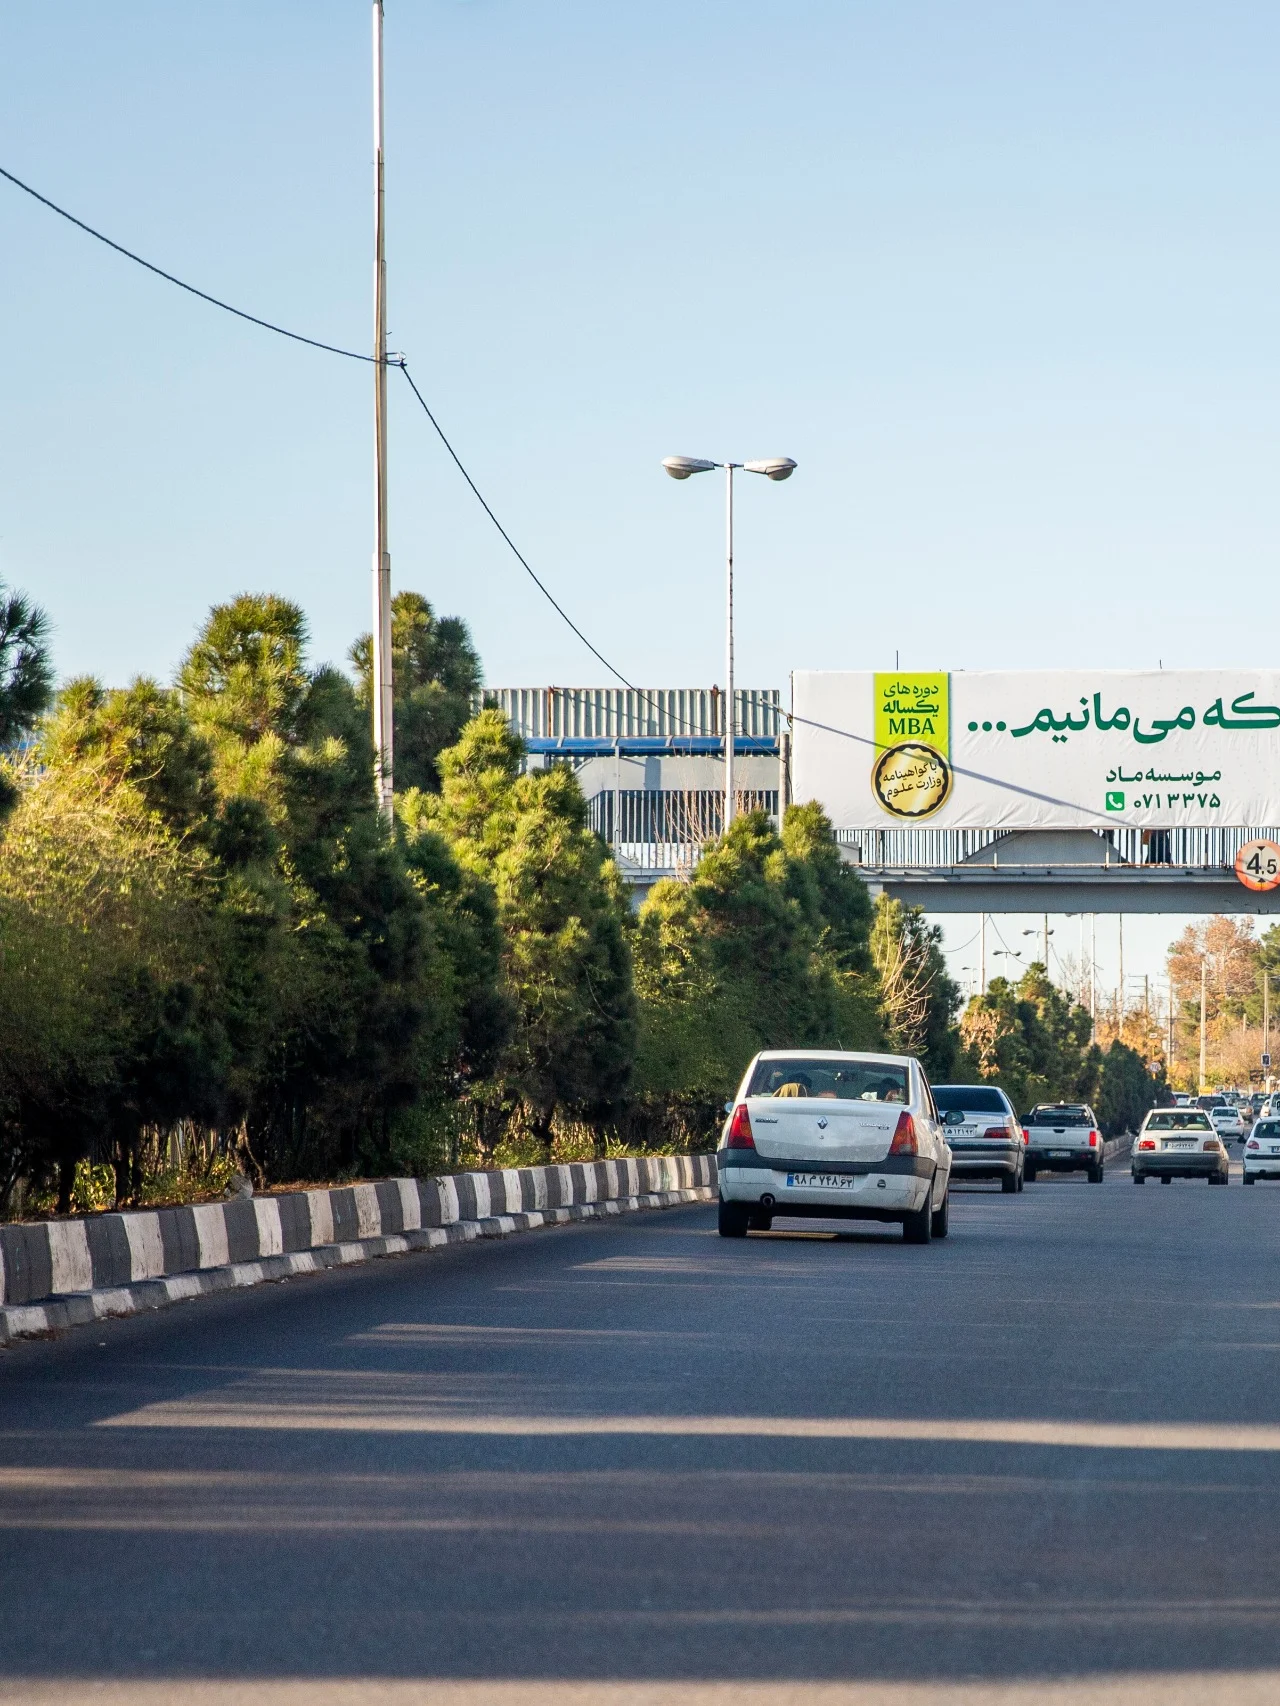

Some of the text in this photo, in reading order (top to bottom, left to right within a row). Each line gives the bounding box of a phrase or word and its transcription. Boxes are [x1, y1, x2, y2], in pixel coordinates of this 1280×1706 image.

[883, 682, 939, 698] دوره های
[882, 699, 940, 717] یکساله
[889, 717, 936, 735] MBA
[1105, 765, 1222, 787] موسسه ماد
[886, 776, 942, 801] وزارت علوم
[1246, 852, 1277, 875] 4.5
